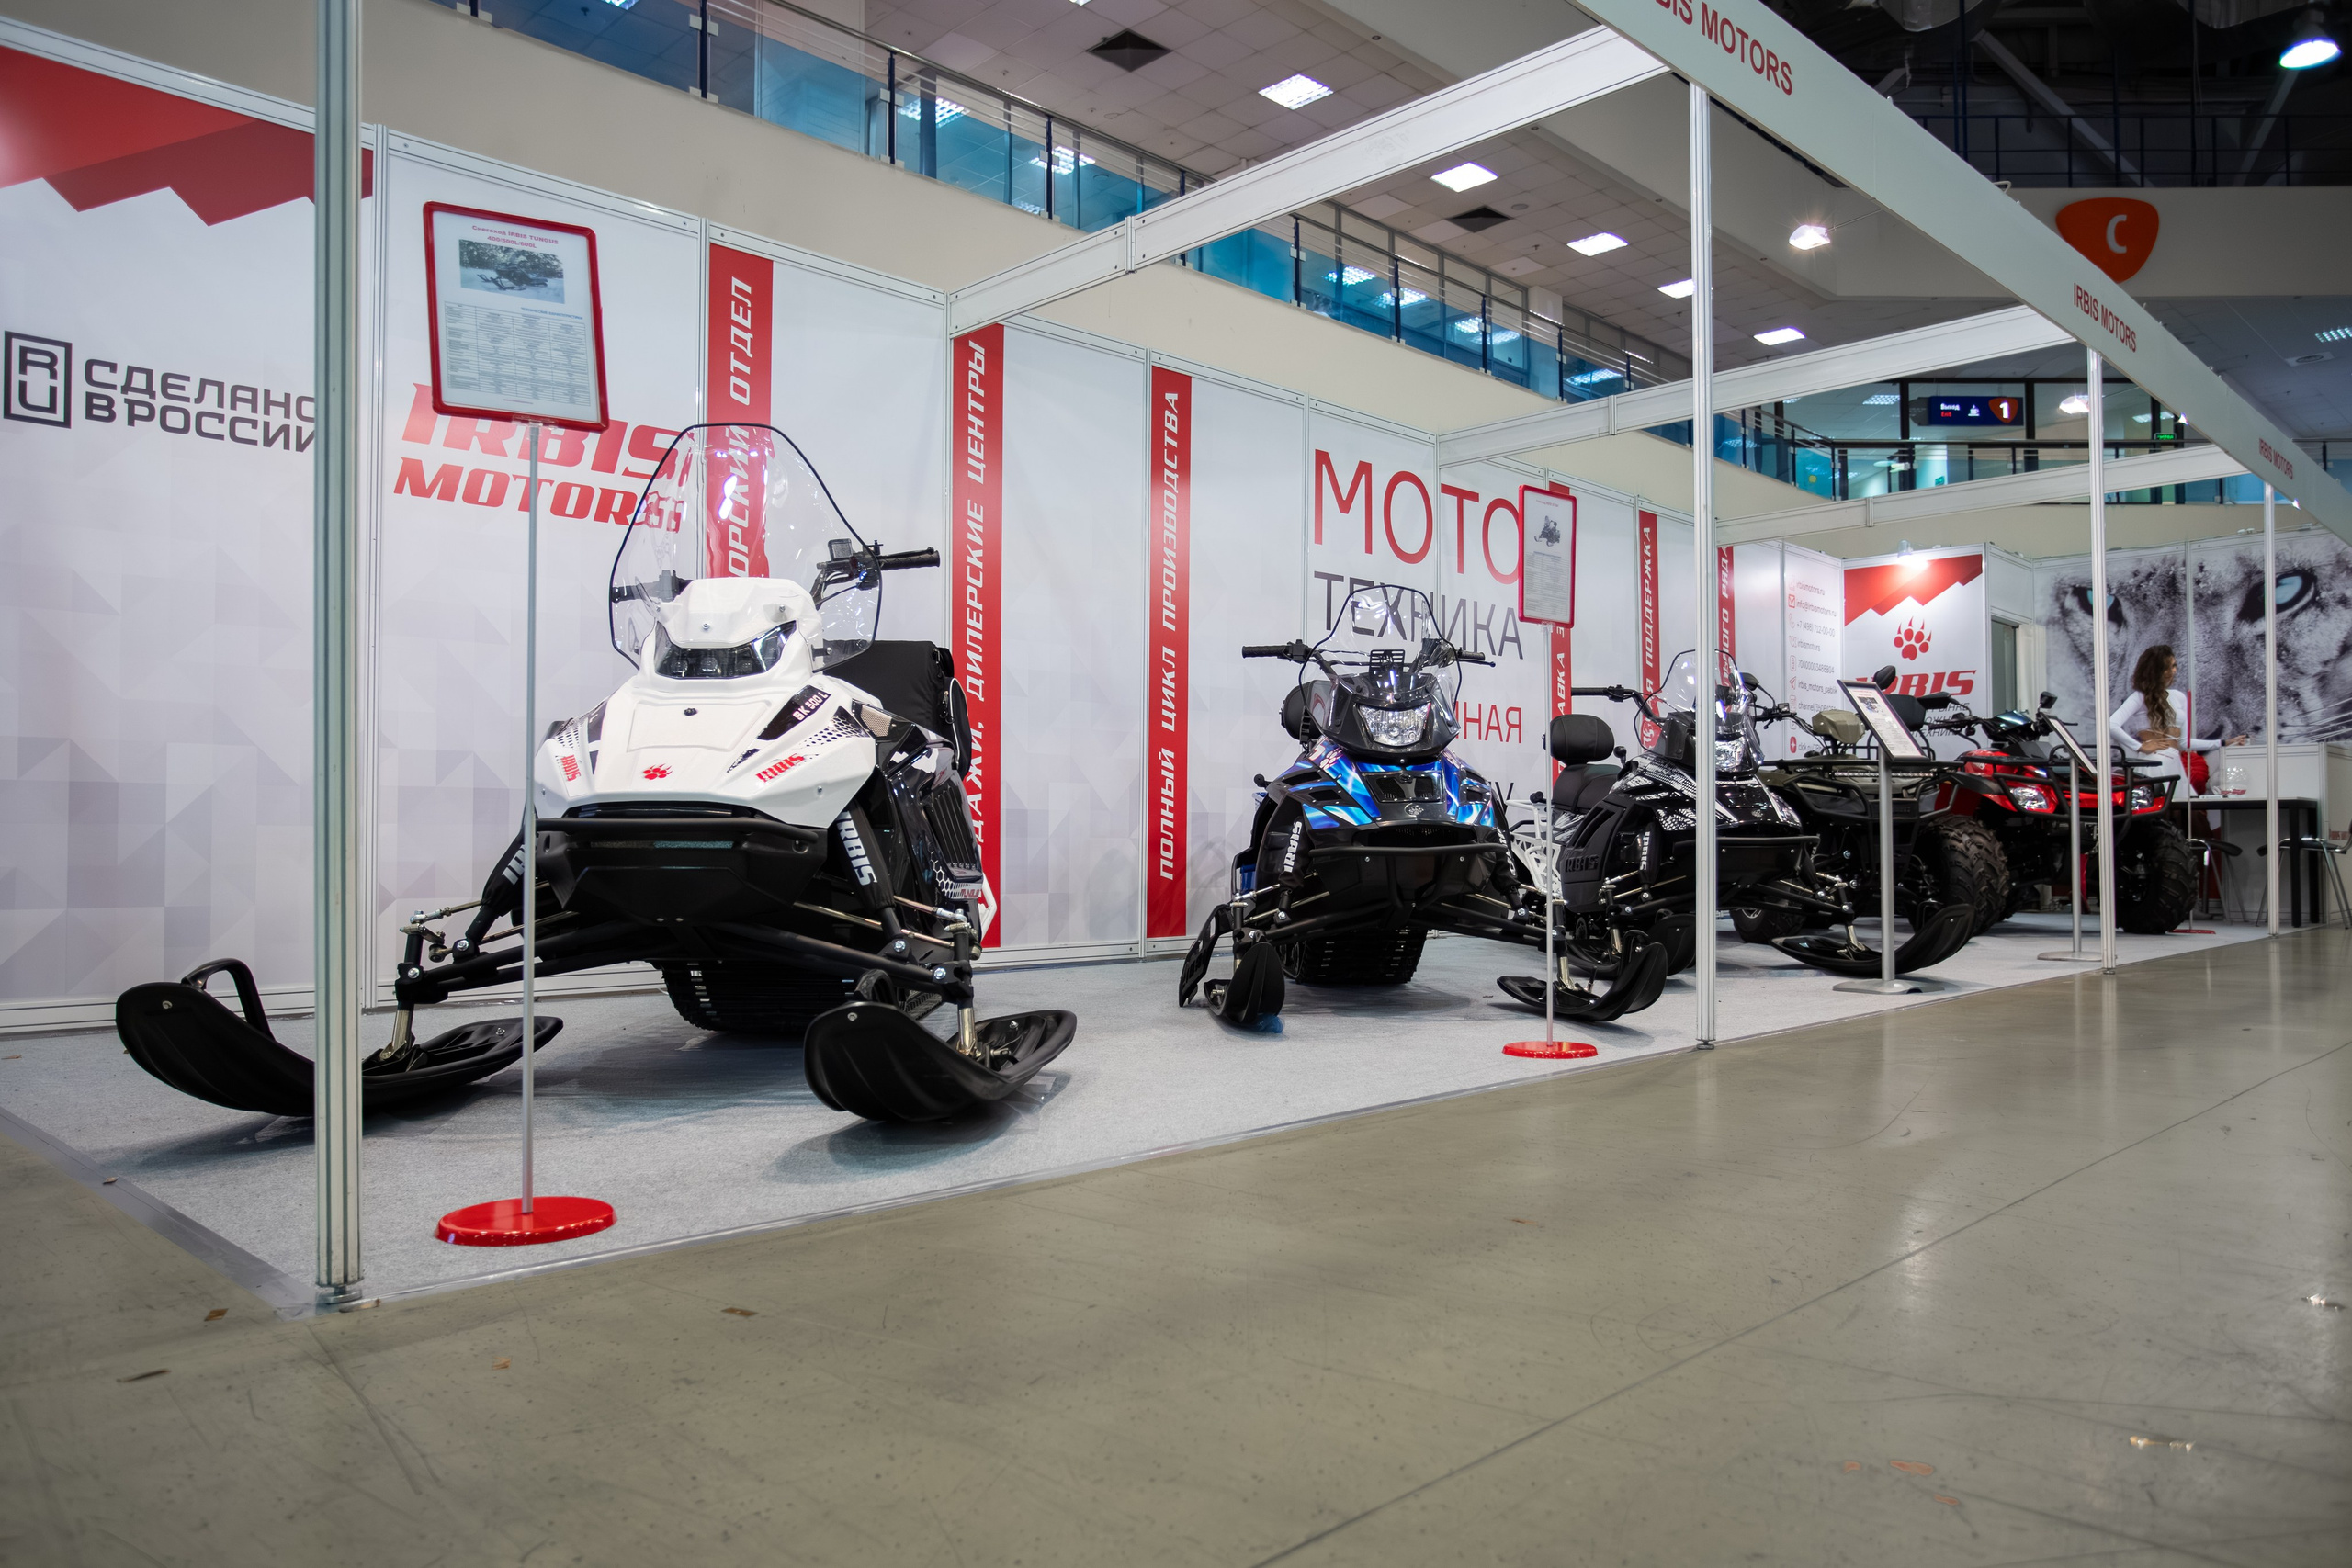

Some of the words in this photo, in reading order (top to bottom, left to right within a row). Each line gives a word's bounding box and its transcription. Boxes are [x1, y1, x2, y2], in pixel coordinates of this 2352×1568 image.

[1701, 3, 1792, 96] MOTORS
[471, 225, 507, 236] Снегоход
[507, 231, 527, 240] IRBIS
[529, 235, 559, 245] TUNGUS
[729, 276, 753, 406] ОТДЕЛ
[2073, 282, 2098, 321] IRBIS
[2100, 304, 2137, 353] MOTORS
[85, 391, 117, 423] В
[967, 340, 986, 485] ЦЕНТРЫ
[1999, 400, 2010, 419] 1
[1162, 392, 1179, 632] ПРОИЗВОДСТВА
[1314, 448, 1520, 585] МОТО
[966, 499, 986, 702] ДИЛЕРСКИЕ
[1314, 570, 1523, 660] ТЕХНИКА
[1643, 526, 1654, 668] ПОДДЕРЖКА
[805, 694, 822, 710] 500
[1161, 646, 1177, 732] ЦИКЛ
[835, 811, 878, 886] IRBIS
[1159, 747, 1175, 881] ПОЛНЫЙ
[1283, 821, 1303, 873] IRBIS
